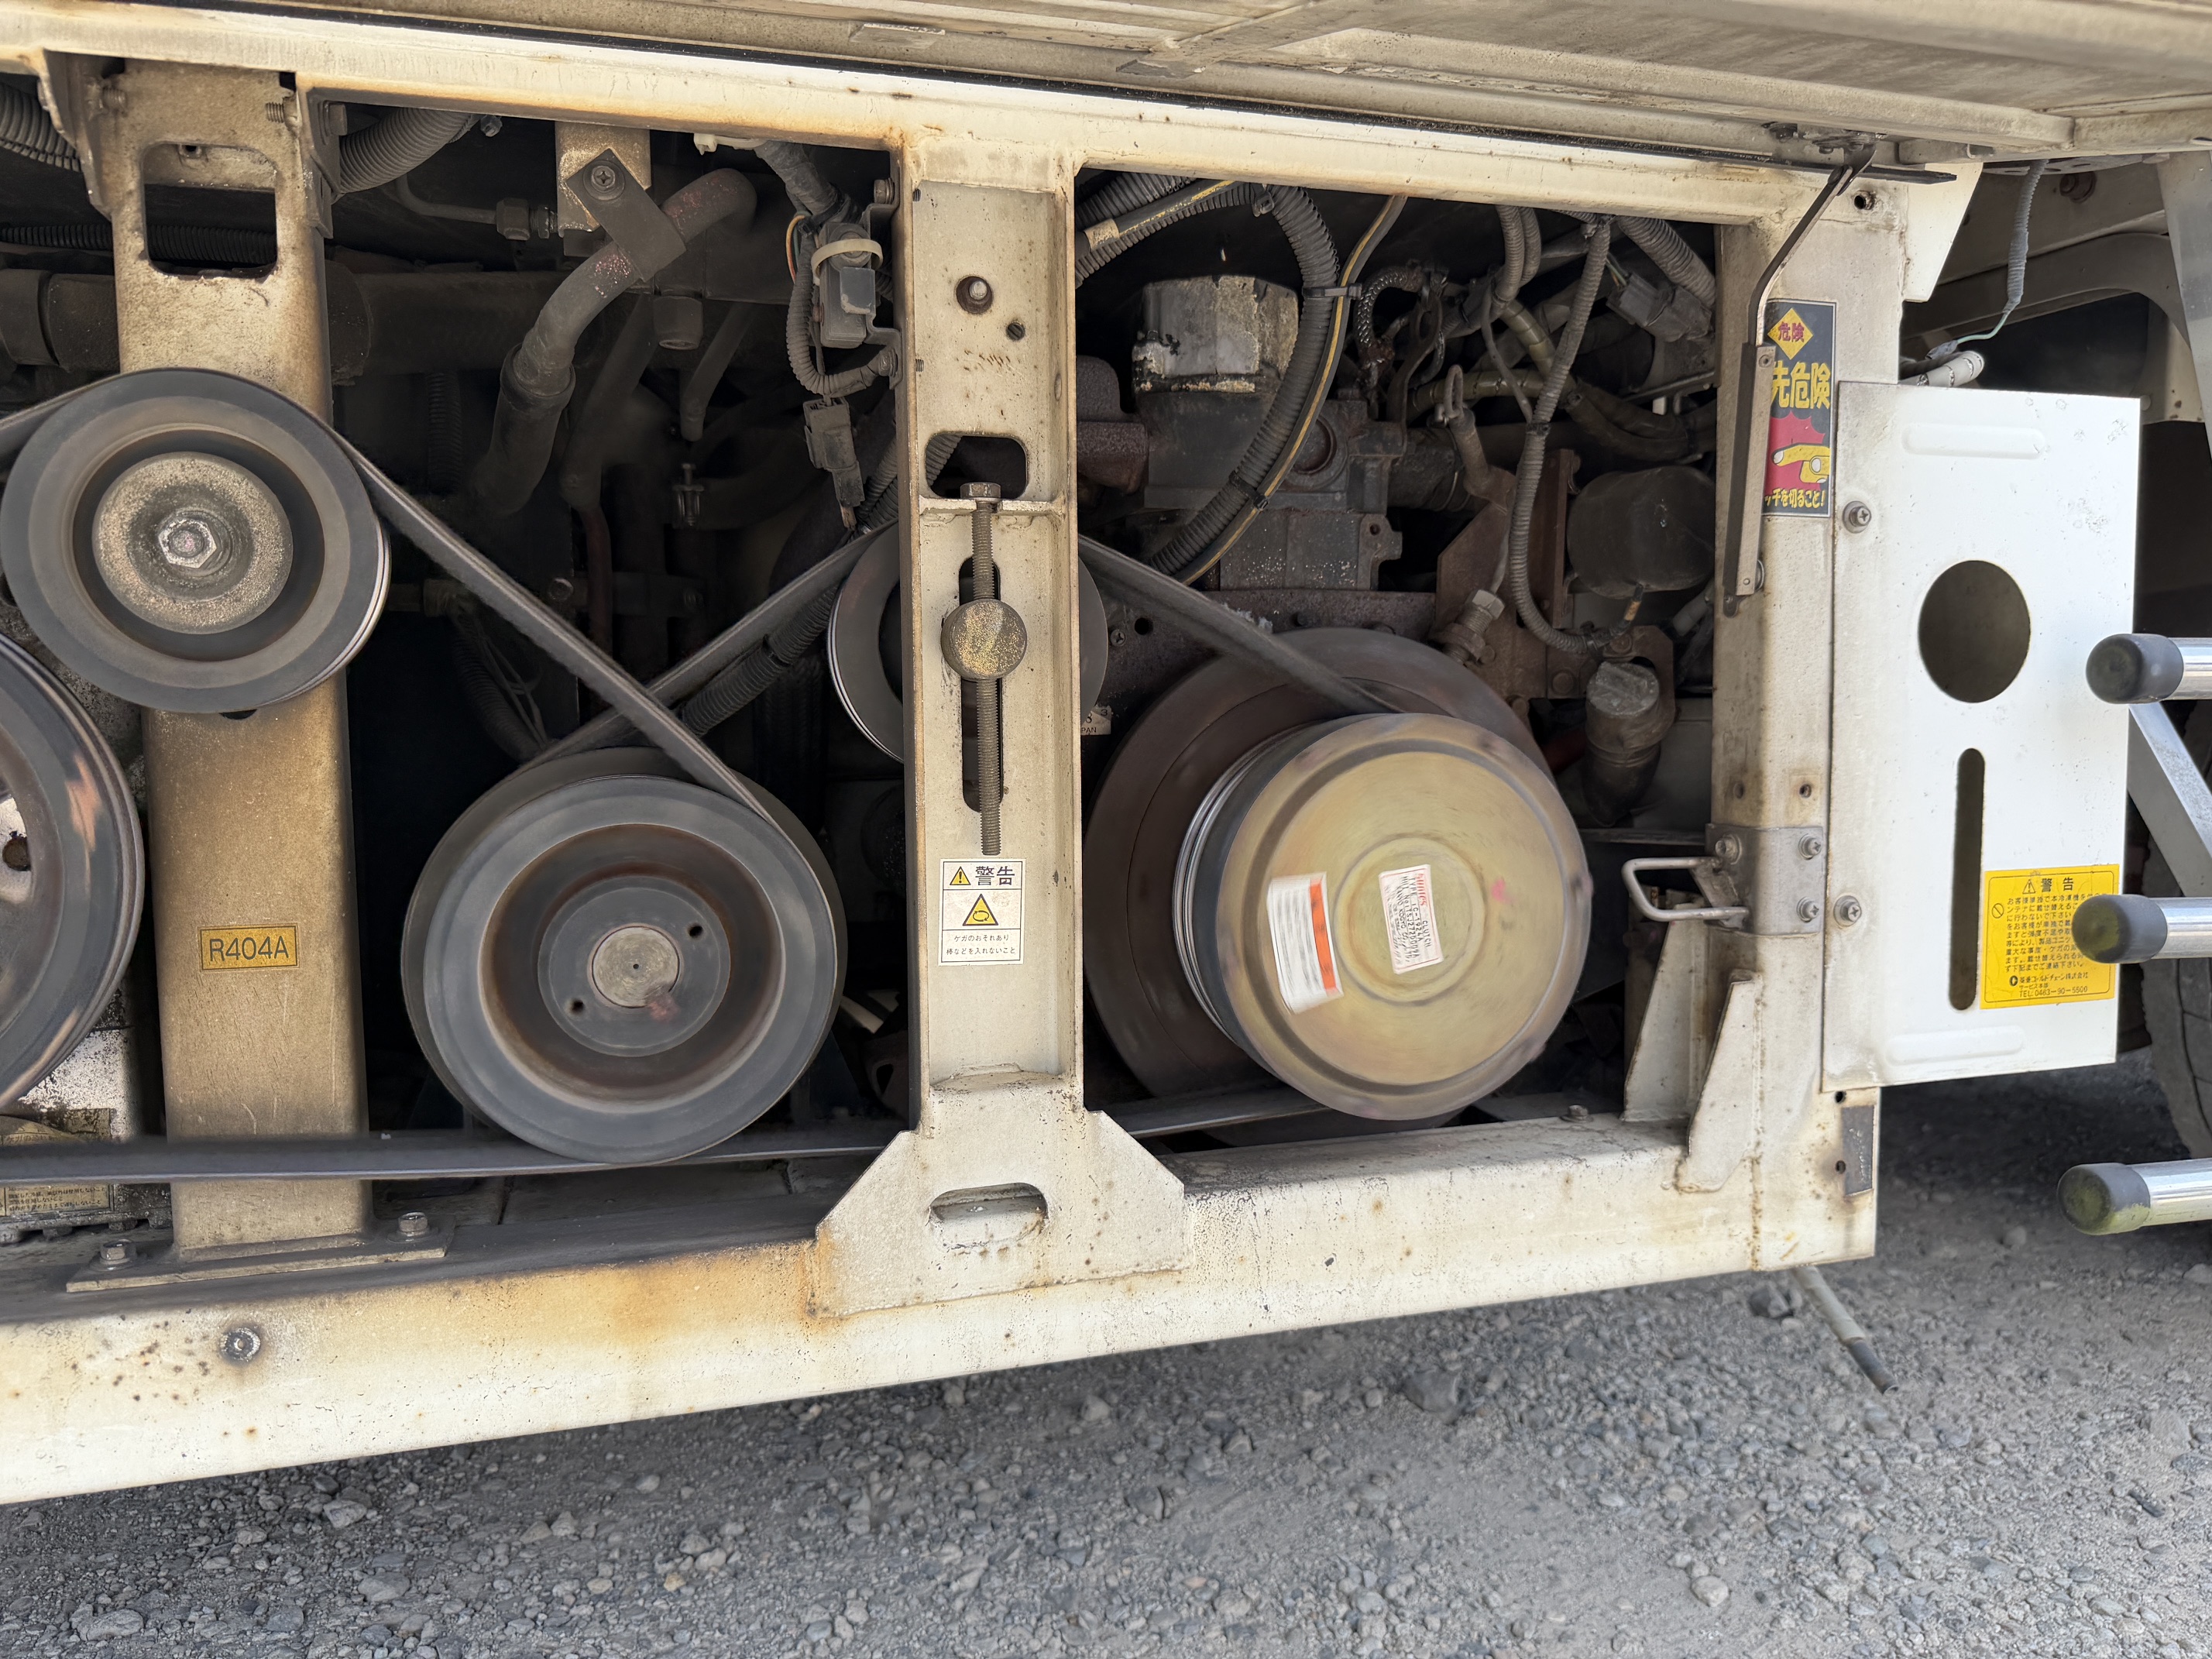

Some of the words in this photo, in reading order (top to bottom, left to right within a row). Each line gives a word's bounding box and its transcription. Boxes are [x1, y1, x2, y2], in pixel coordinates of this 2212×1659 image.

[1778, 321, 1805, 343] 危険
[974, 865, 1015, 886] 警告
[2040, 877, 2075, 893] 警告
[209, 935, 290, 962] R404A
[946, 946, 1016, 955] 棒などを入れないこと
